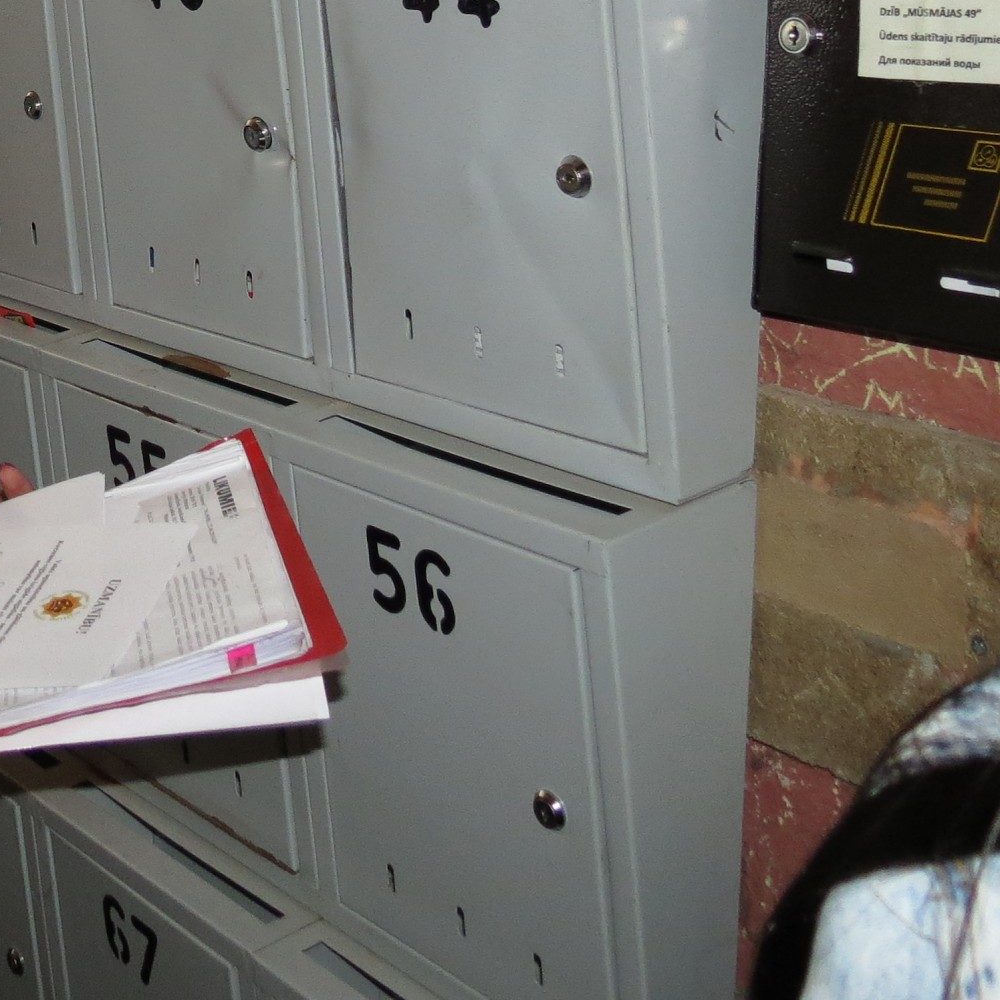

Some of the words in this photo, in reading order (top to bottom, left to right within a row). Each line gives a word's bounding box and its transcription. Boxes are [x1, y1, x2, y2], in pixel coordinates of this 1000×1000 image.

[879, 29, 908, 41] Ūdens
[877, 55, 898, 66] Для
[899, 56, 951, 68] показаний
[953, 59, 981, 70] воды
[366, 524, 456, 635] 56
[102, 894, 158, 986] 67
